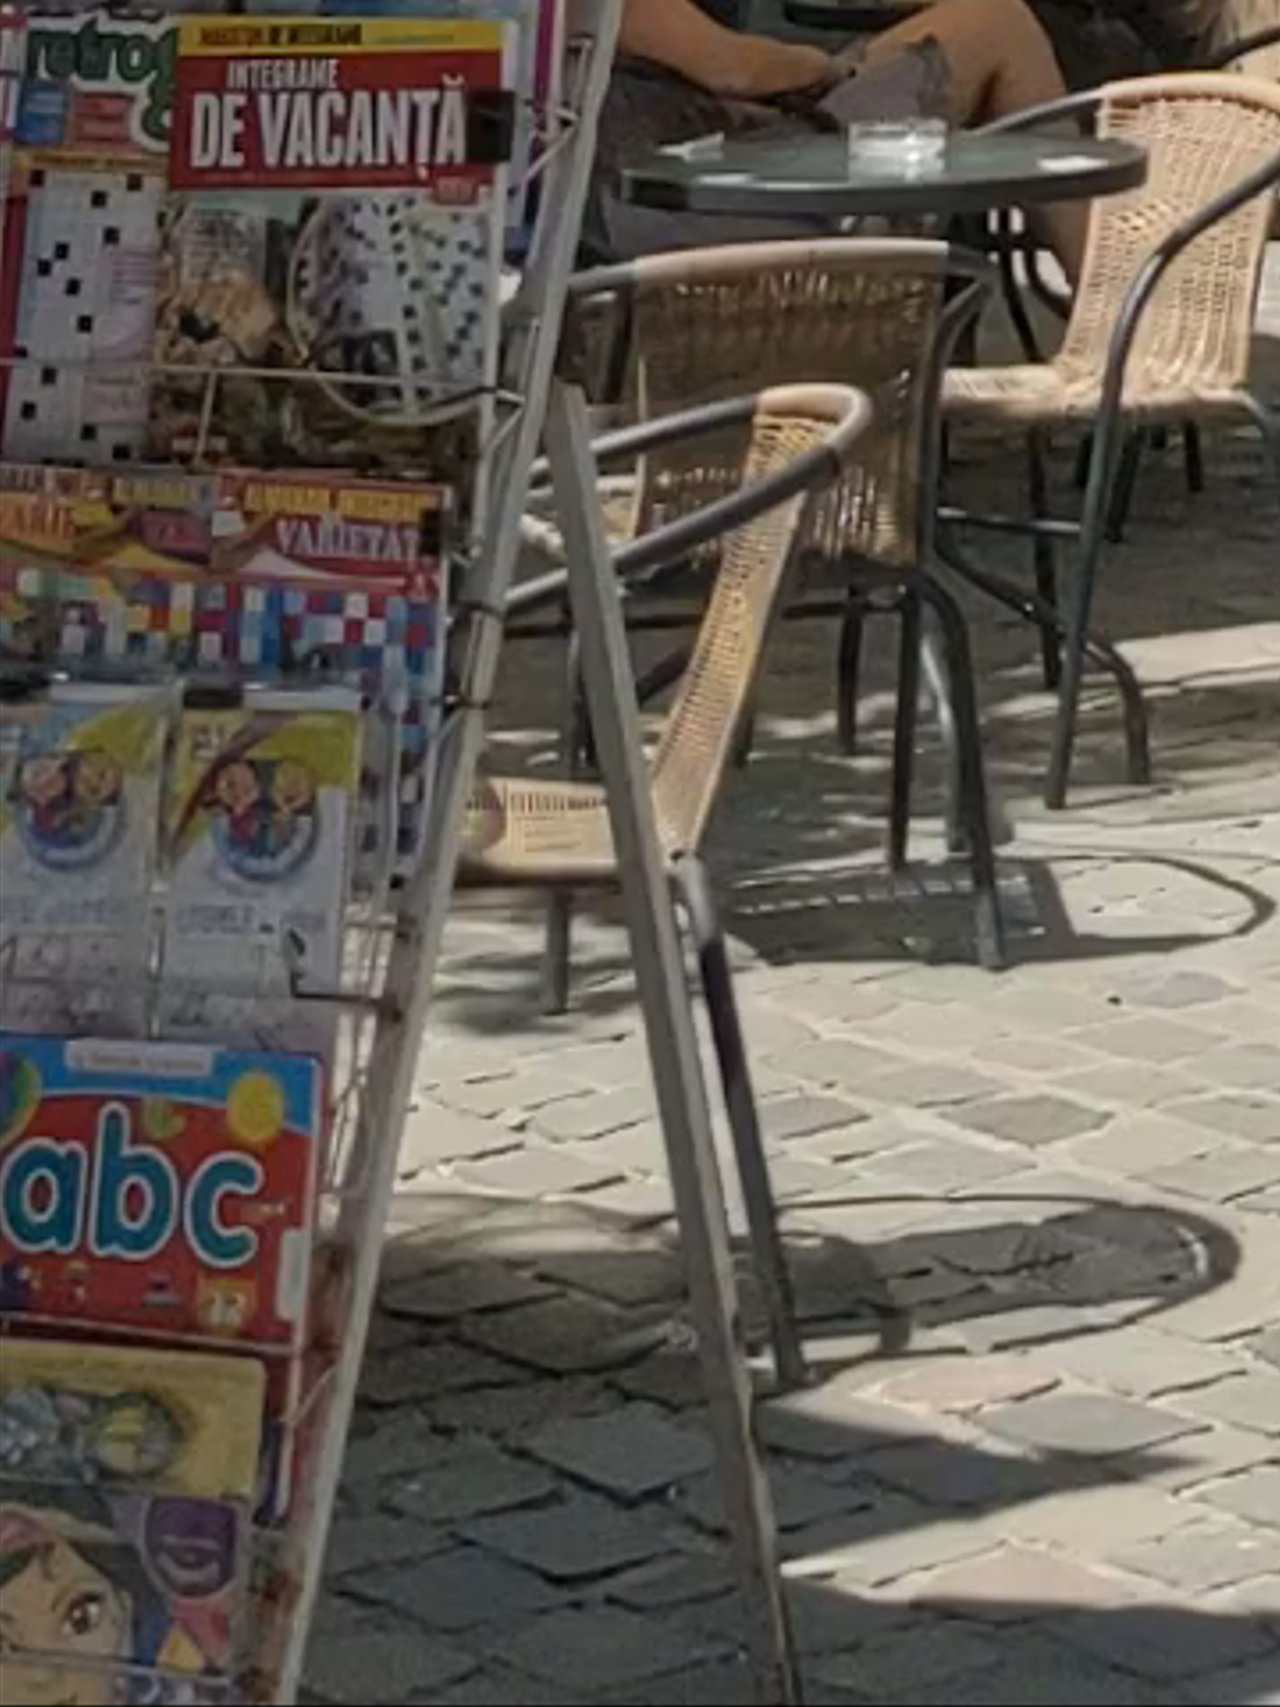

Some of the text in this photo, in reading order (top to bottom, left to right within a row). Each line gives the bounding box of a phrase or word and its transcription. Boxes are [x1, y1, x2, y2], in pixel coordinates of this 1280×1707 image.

[190, 73, 468, 181] DE VACANȚĂ
[226, 58, 340, 90] INTEGRAME
[0, 1099, 264, 1269] abc
